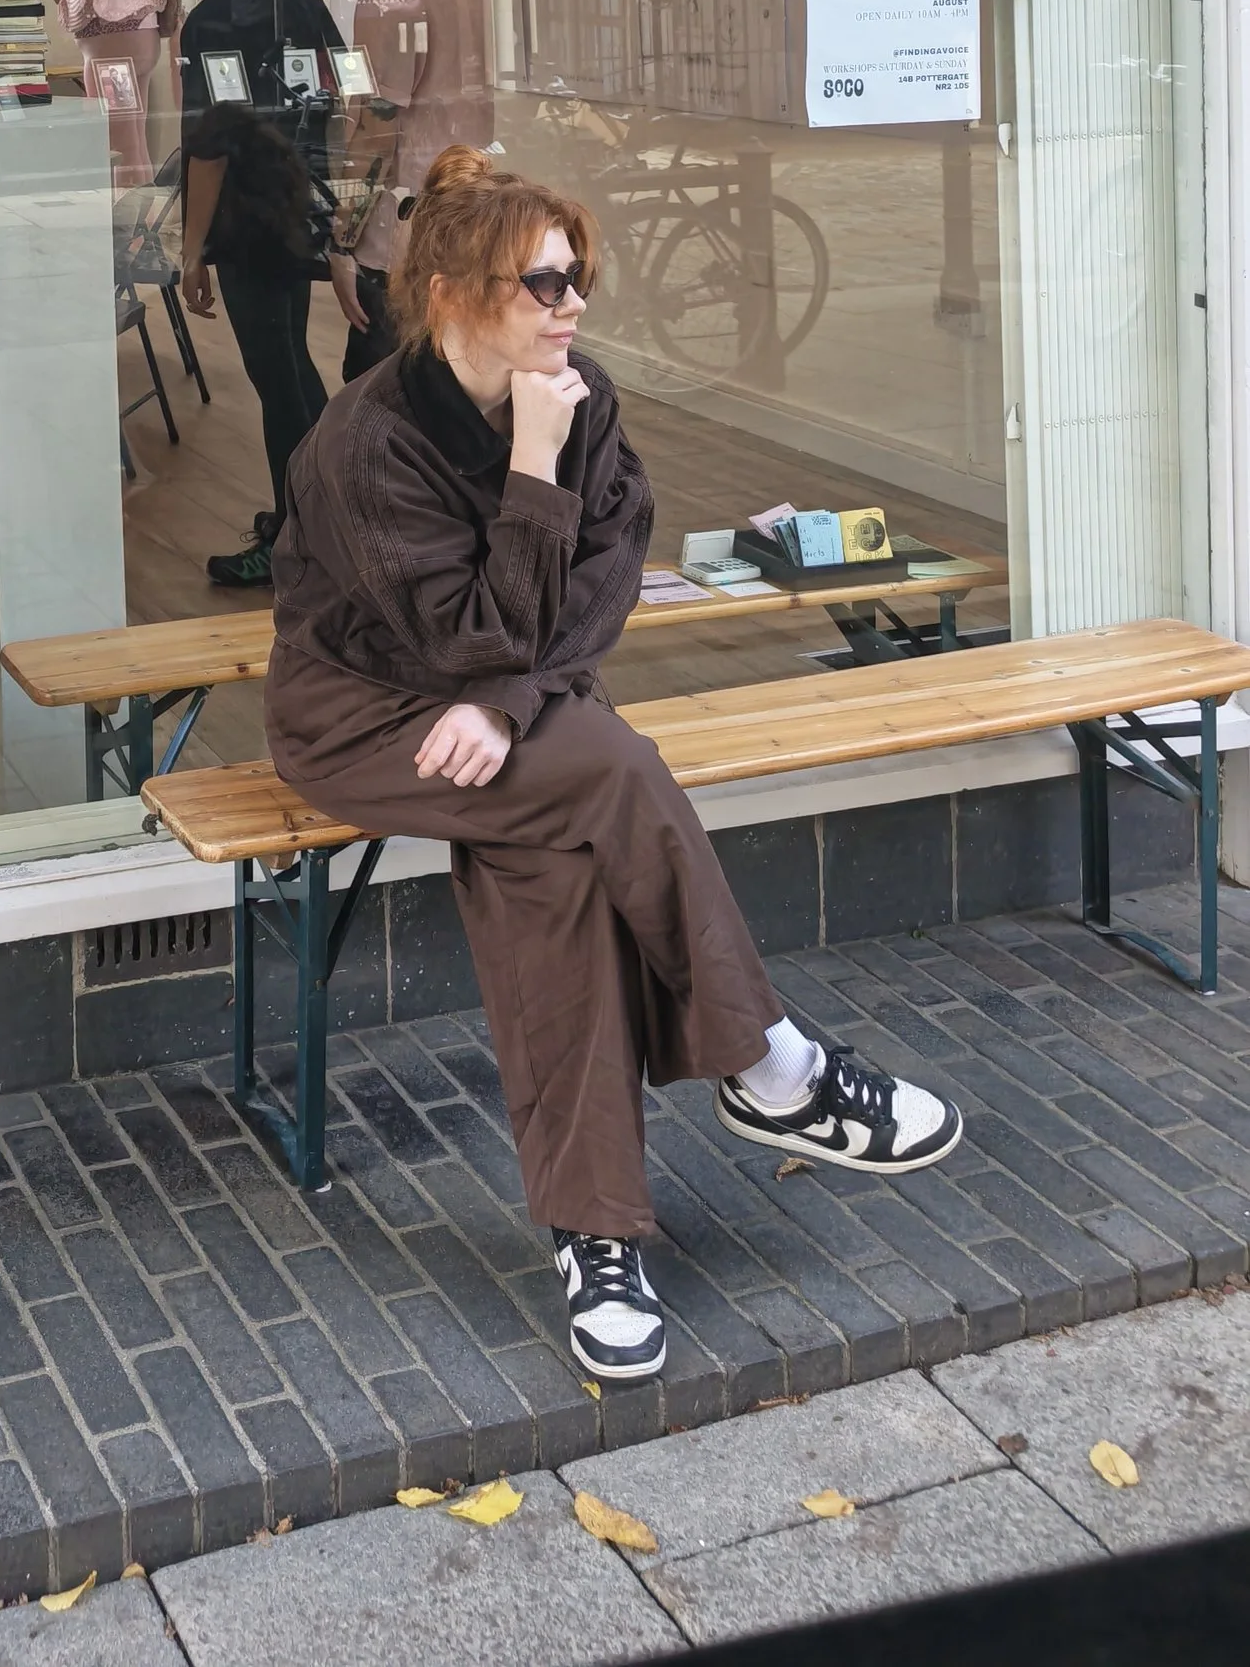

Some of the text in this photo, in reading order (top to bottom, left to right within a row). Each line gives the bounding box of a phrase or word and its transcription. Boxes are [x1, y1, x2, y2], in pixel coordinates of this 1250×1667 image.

[932, 0, 969, 7] AUGUST
[855, 11, 882, 22] OPEN
[884, 10, 914, 20] DAILY
[893, 46, 970, 57] @FINDINGAVOICE
[823, 63, 877, 74] WORKSHOPS
[878, 61, 925, 72] SATURDAY
[934, 59, 969, 69] SUNDAY
[915, 73, 970, 82] POTTERGATE
[935, 83, 952, 91] NR2
[806, 1071, 820, 1092] NIKE
